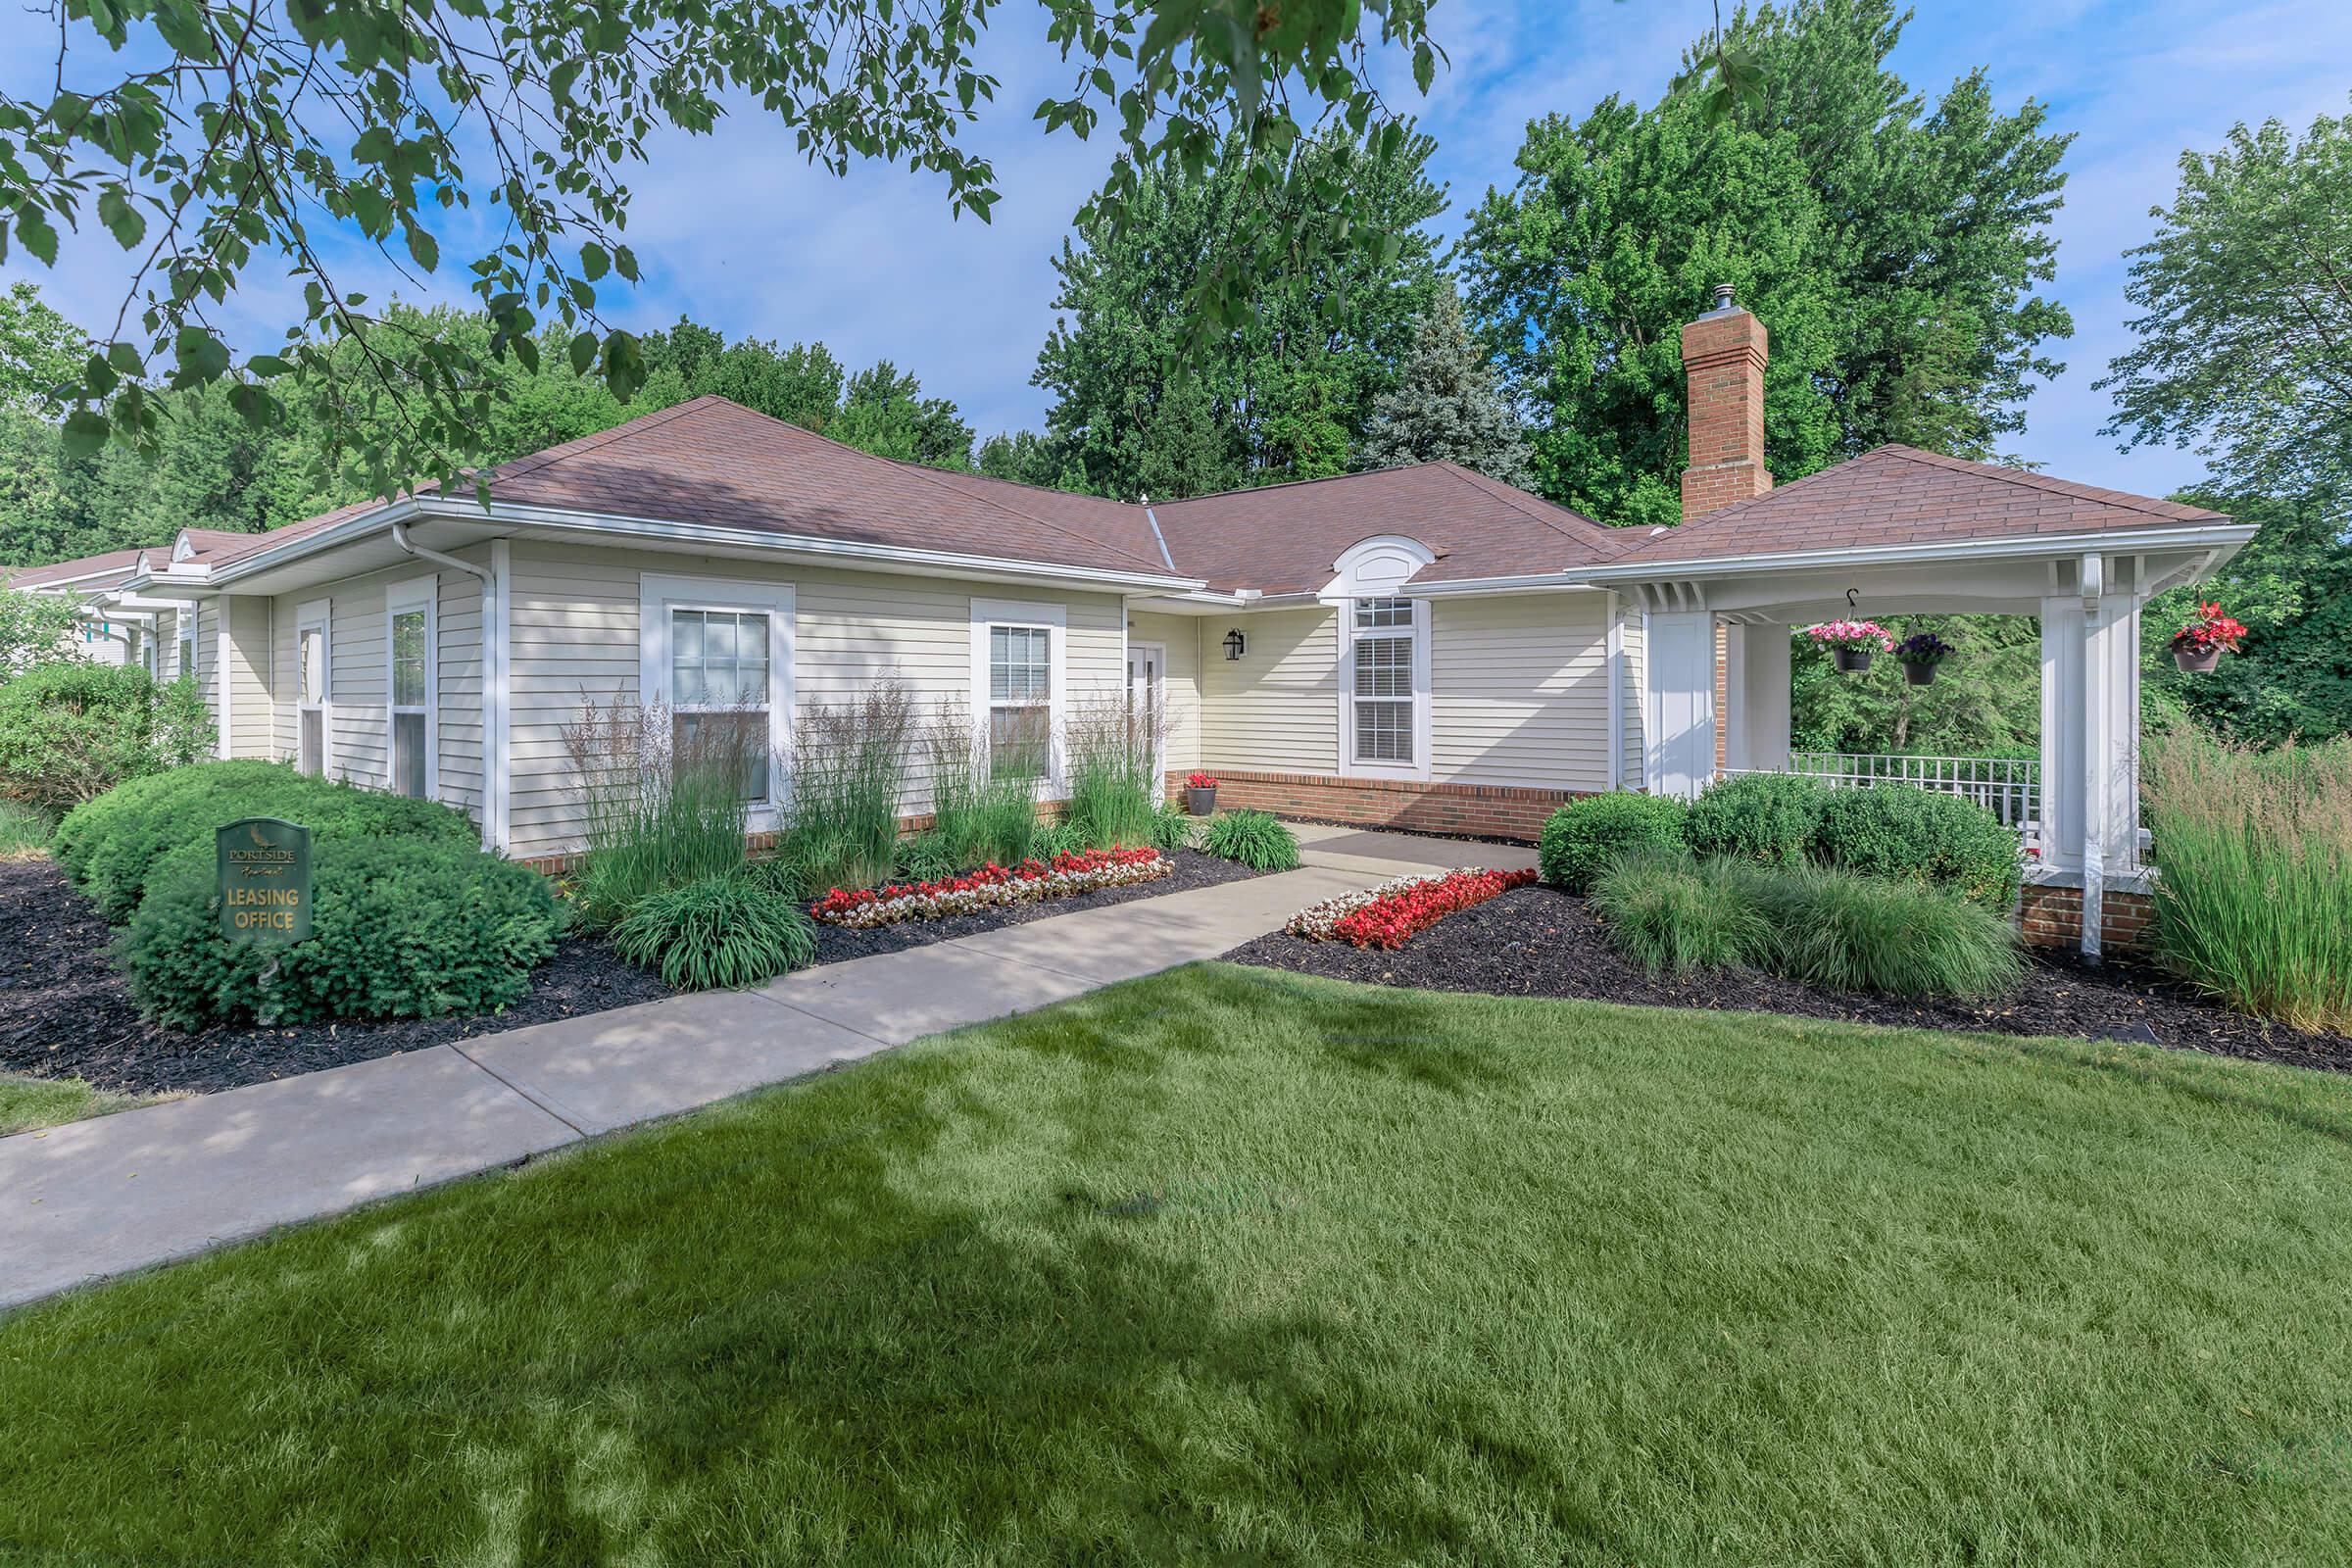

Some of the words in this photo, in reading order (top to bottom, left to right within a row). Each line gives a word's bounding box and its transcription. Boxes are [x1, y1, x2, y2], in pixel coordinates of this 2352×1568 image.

[229, 850, 294, 859] PORTSIDE
[227, 888, 298, 906] LEASING
[235, 911, 294, 929] OFFICE
